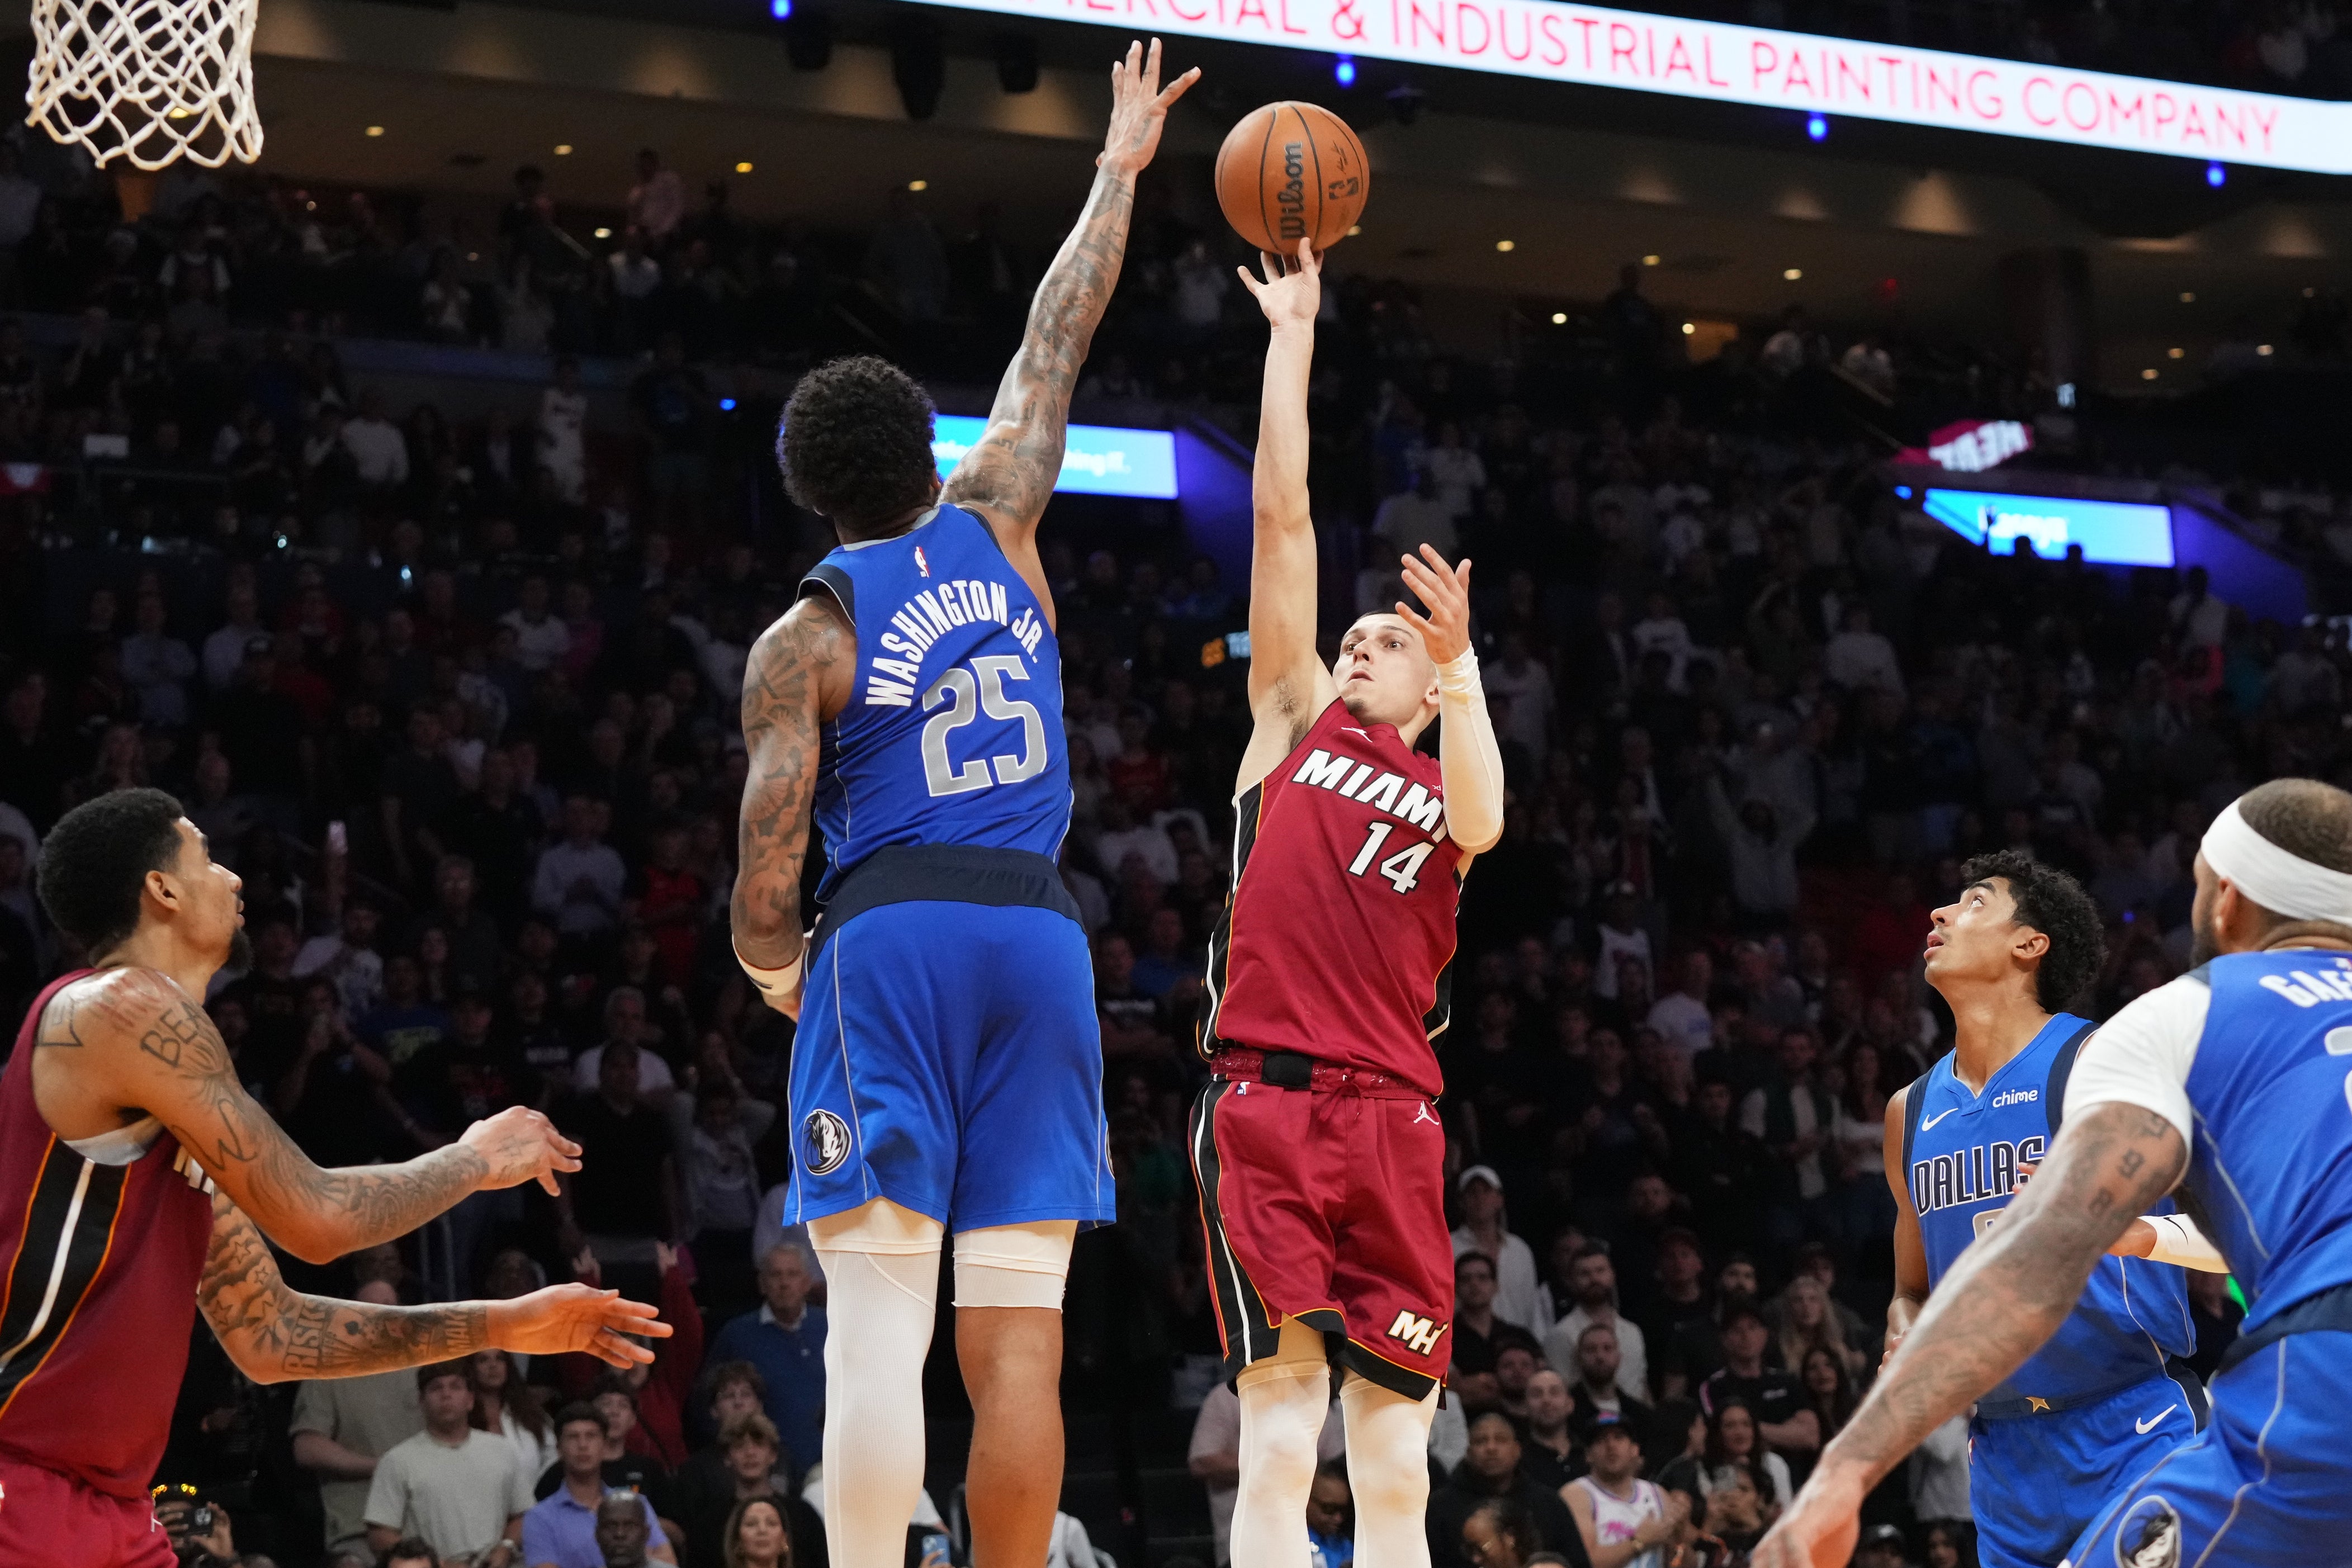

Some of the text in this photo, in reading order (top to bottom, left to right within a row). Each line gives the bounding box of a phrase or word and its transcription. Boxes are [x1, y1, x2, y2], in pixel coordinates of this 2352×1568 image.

[1332, 0, 1368, 41] &
[1391, 0, 1729, 87] INDUSTRIAL
[1751, 41, 2003, 120] PAINTING
[2022, 77, 2279, 152] COMPANY
[1277, 141, 1307, 239] Wilson
[865, 580, 1043, 707] WASHINGTON JR.
[921, 655, 1047, 797] 25
[1348, 821, 1435, 894] 14
[1993, 1089, 2038, 1108] chime
[1913, 1135, 2045, 1218] DALLAS
